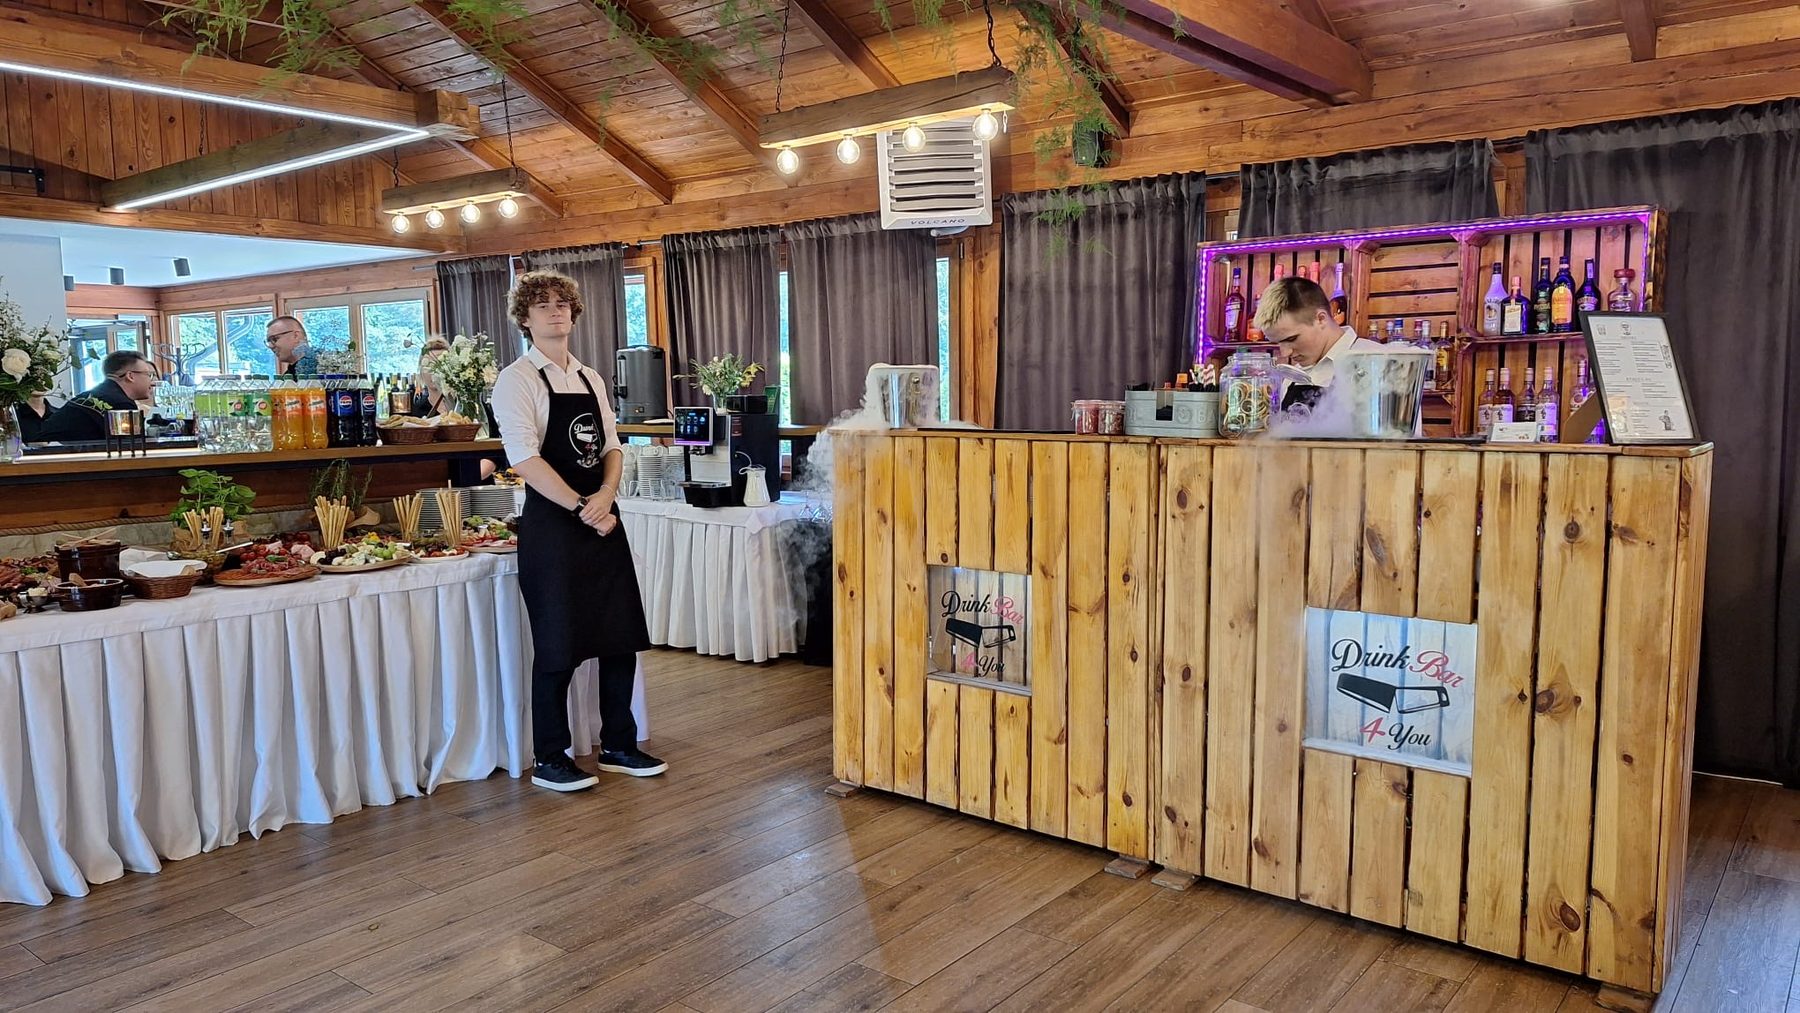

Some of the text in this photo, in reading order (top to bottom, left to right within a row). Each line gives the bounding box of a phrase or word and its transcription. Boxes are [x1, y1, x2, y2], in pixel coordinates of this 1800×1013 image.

[941, 590, 1024, 625] Drink Bar
[960, 651, 1005, 677] 4 You
[1331, 638, 1465, 688] Drink Bar
[1359, 717, 1432, 750] 4 You
